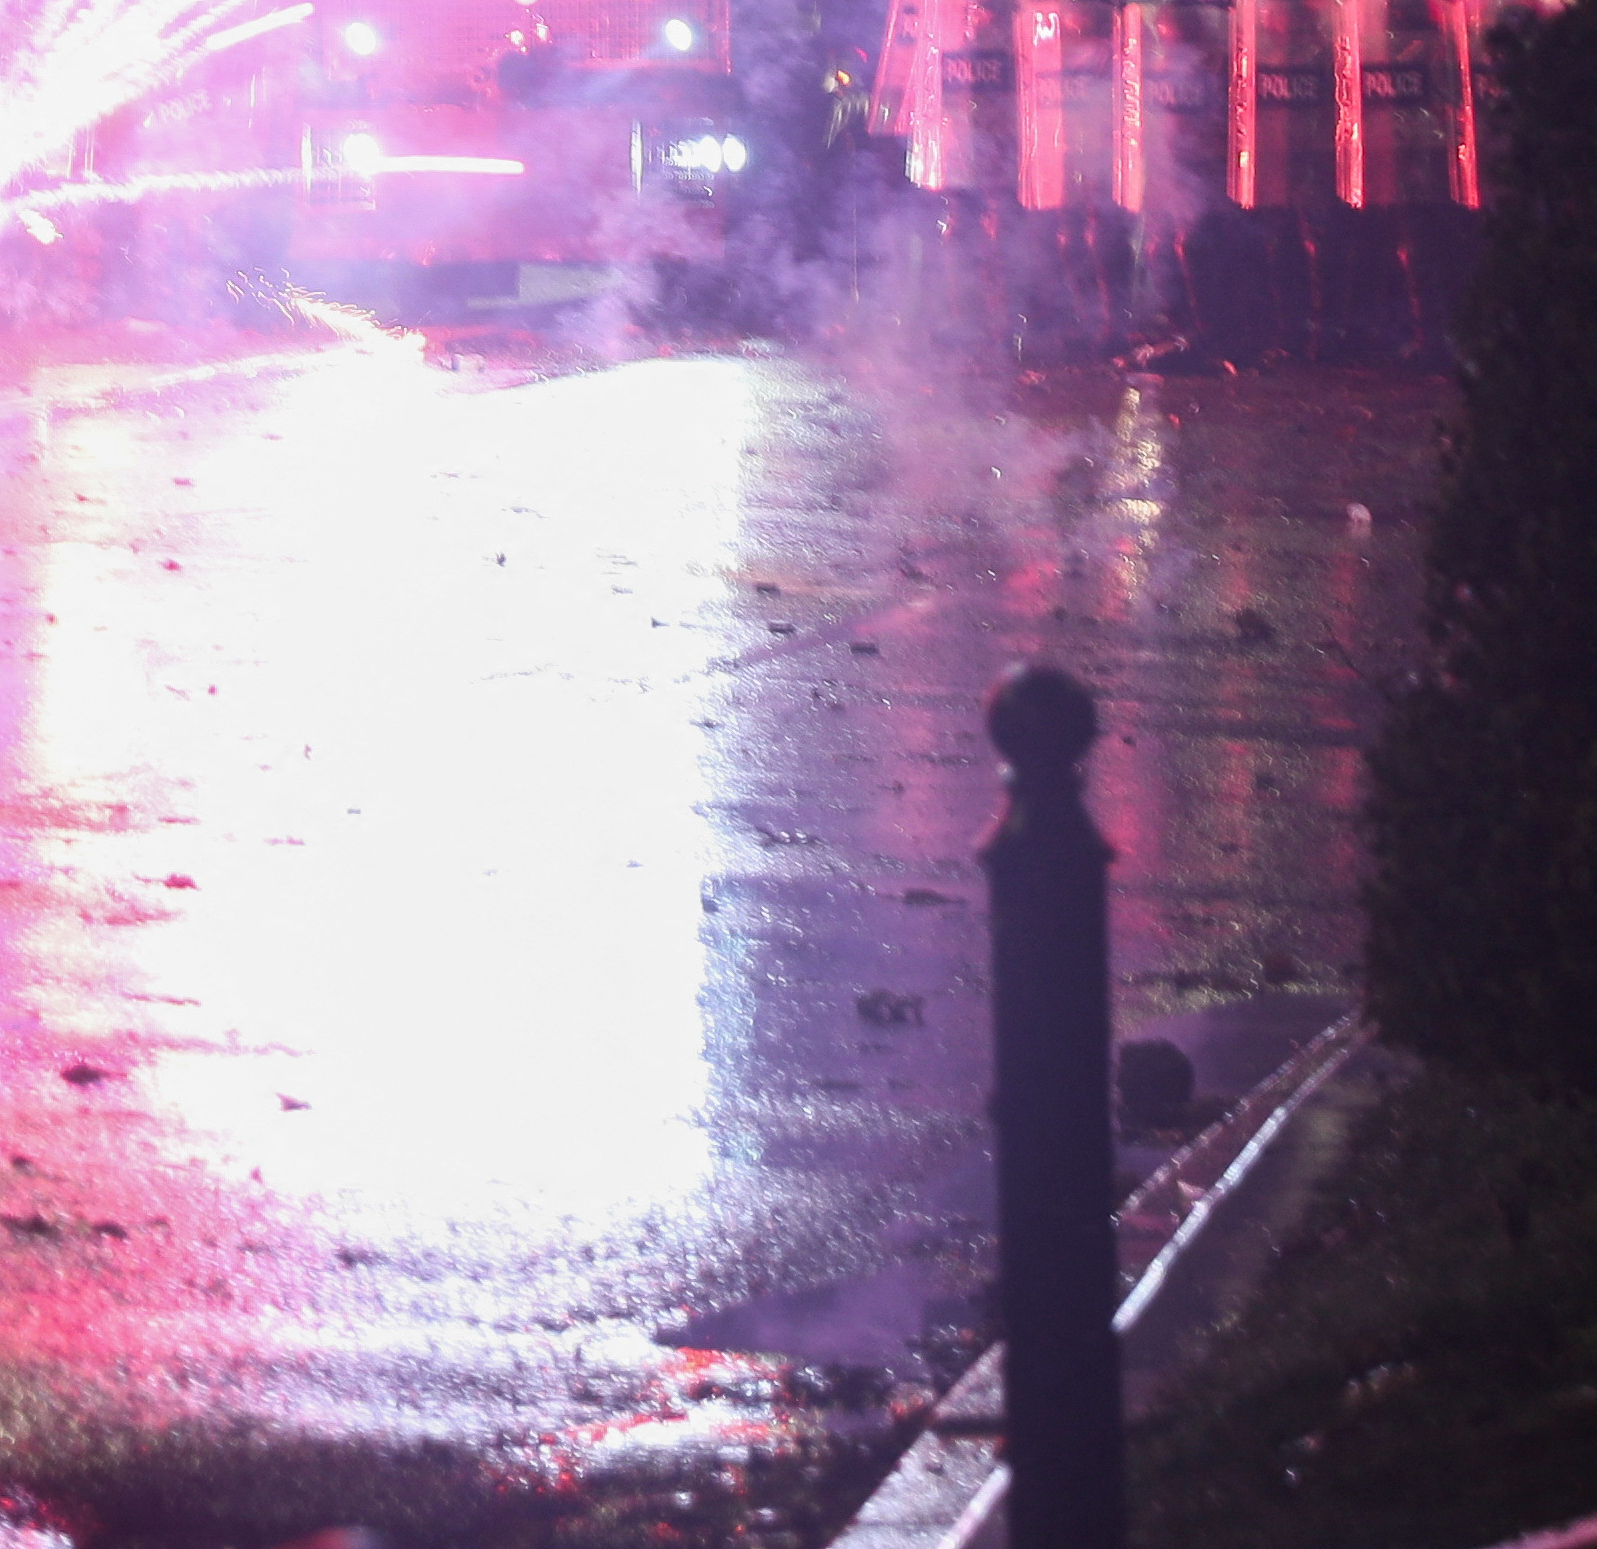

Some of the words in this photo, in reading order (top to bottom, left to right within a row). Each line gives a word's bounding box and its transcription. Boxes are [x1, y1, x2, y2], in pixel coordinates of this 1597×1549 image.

[945, 58, 1002, 82] POLICE
[1259, 73, 1318, 100] POLICE
[1364, 71, 1423, 99] POLICE
